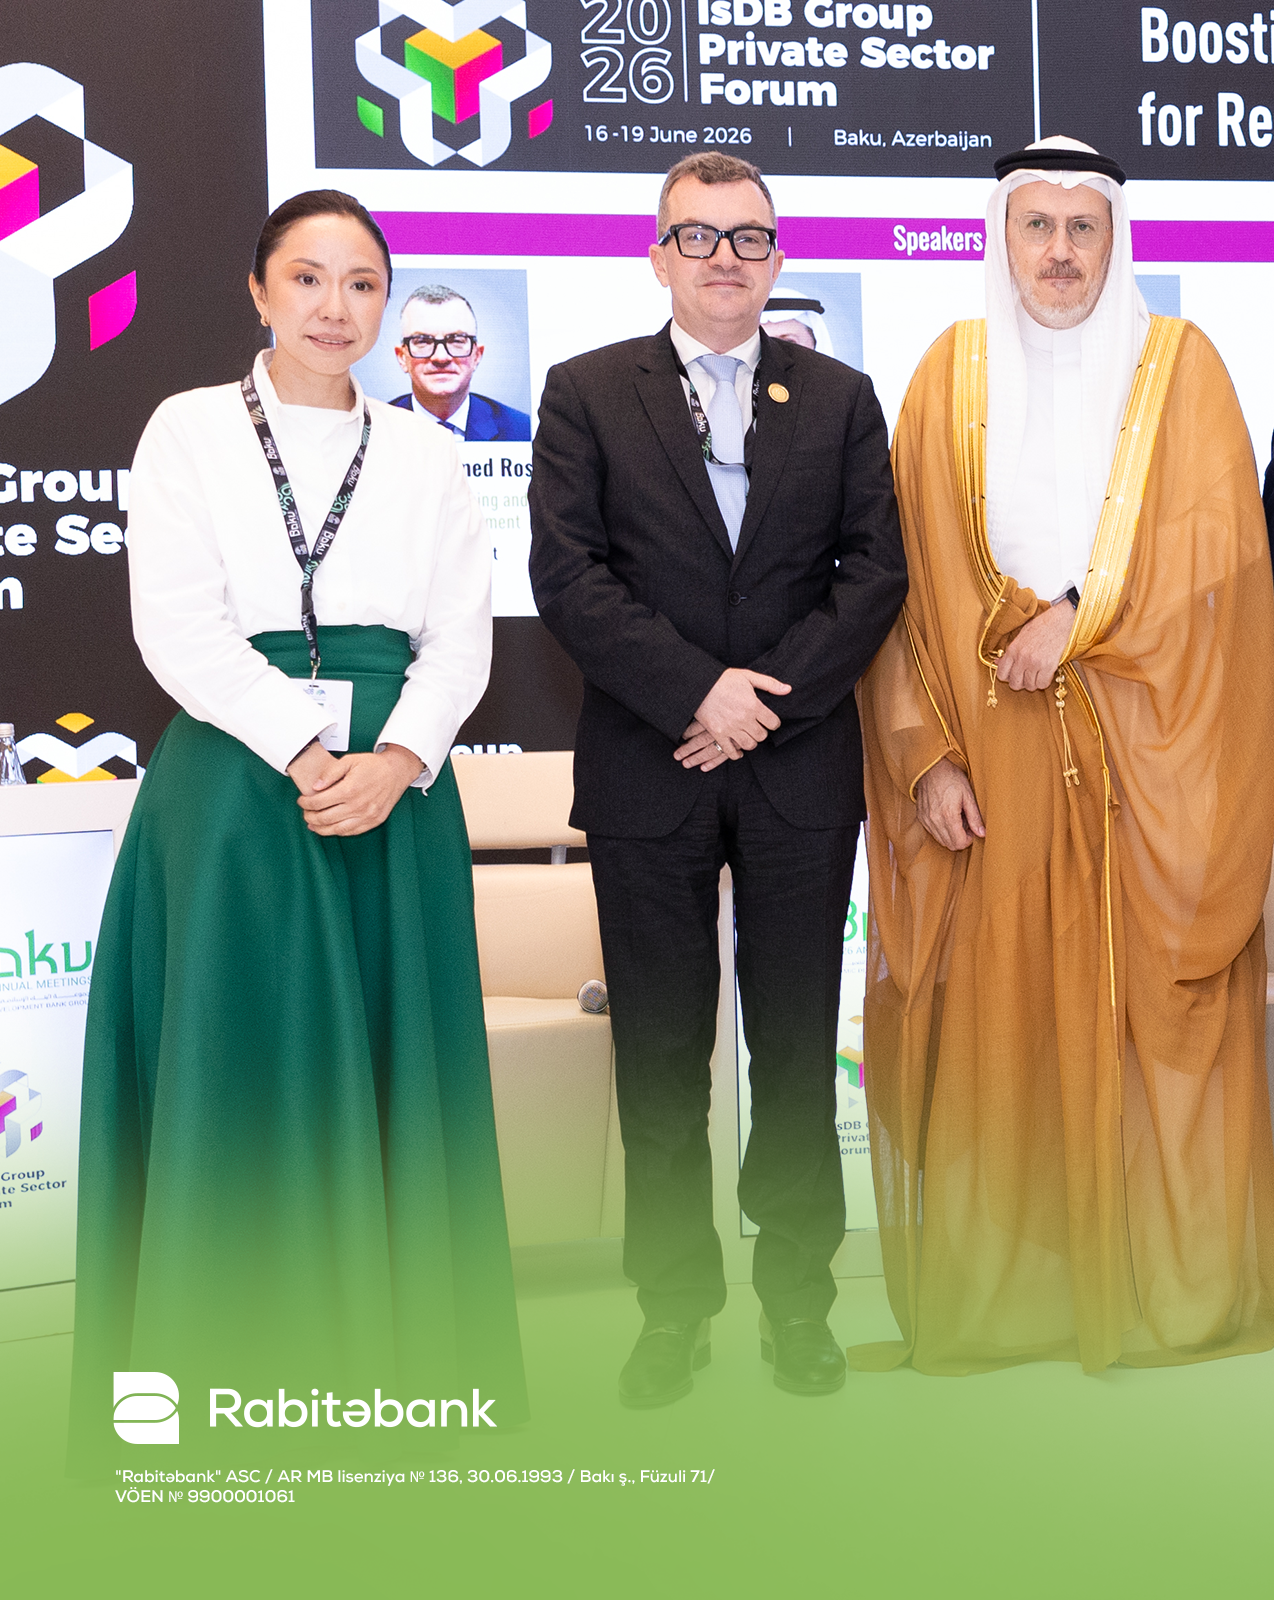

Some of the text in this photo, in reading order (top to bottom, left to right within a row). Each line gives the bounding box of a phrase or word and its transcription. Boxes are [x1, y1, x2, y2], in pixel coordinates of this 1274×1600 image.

[580, 0, 672, 45] 20
[699, 0, 933, 37] IsDB Group
[699, 31, 994, 70] Private Sector
[580, 46, 674, 104] 26
[700, 72, 838, 106] Forum
[1138, 90, 1203, 147] for
[649, 126, 698, 144] June
[703, 127, 752, 144] 2026
[834, 129, 886, 147] Baku,
[891, 129, 992, 152] Azerbaijan
[893, 224, 984, 256] Speakers
[54, 513, 129, 556] Se
[287, 511, 301, 538] Baku
[316, 530, 335, 555] Baku
[0, 981, 33, 991] NUAL
[1, 1169, 45, 1182] Group
[20, 1180, 67, 1193] Sector
